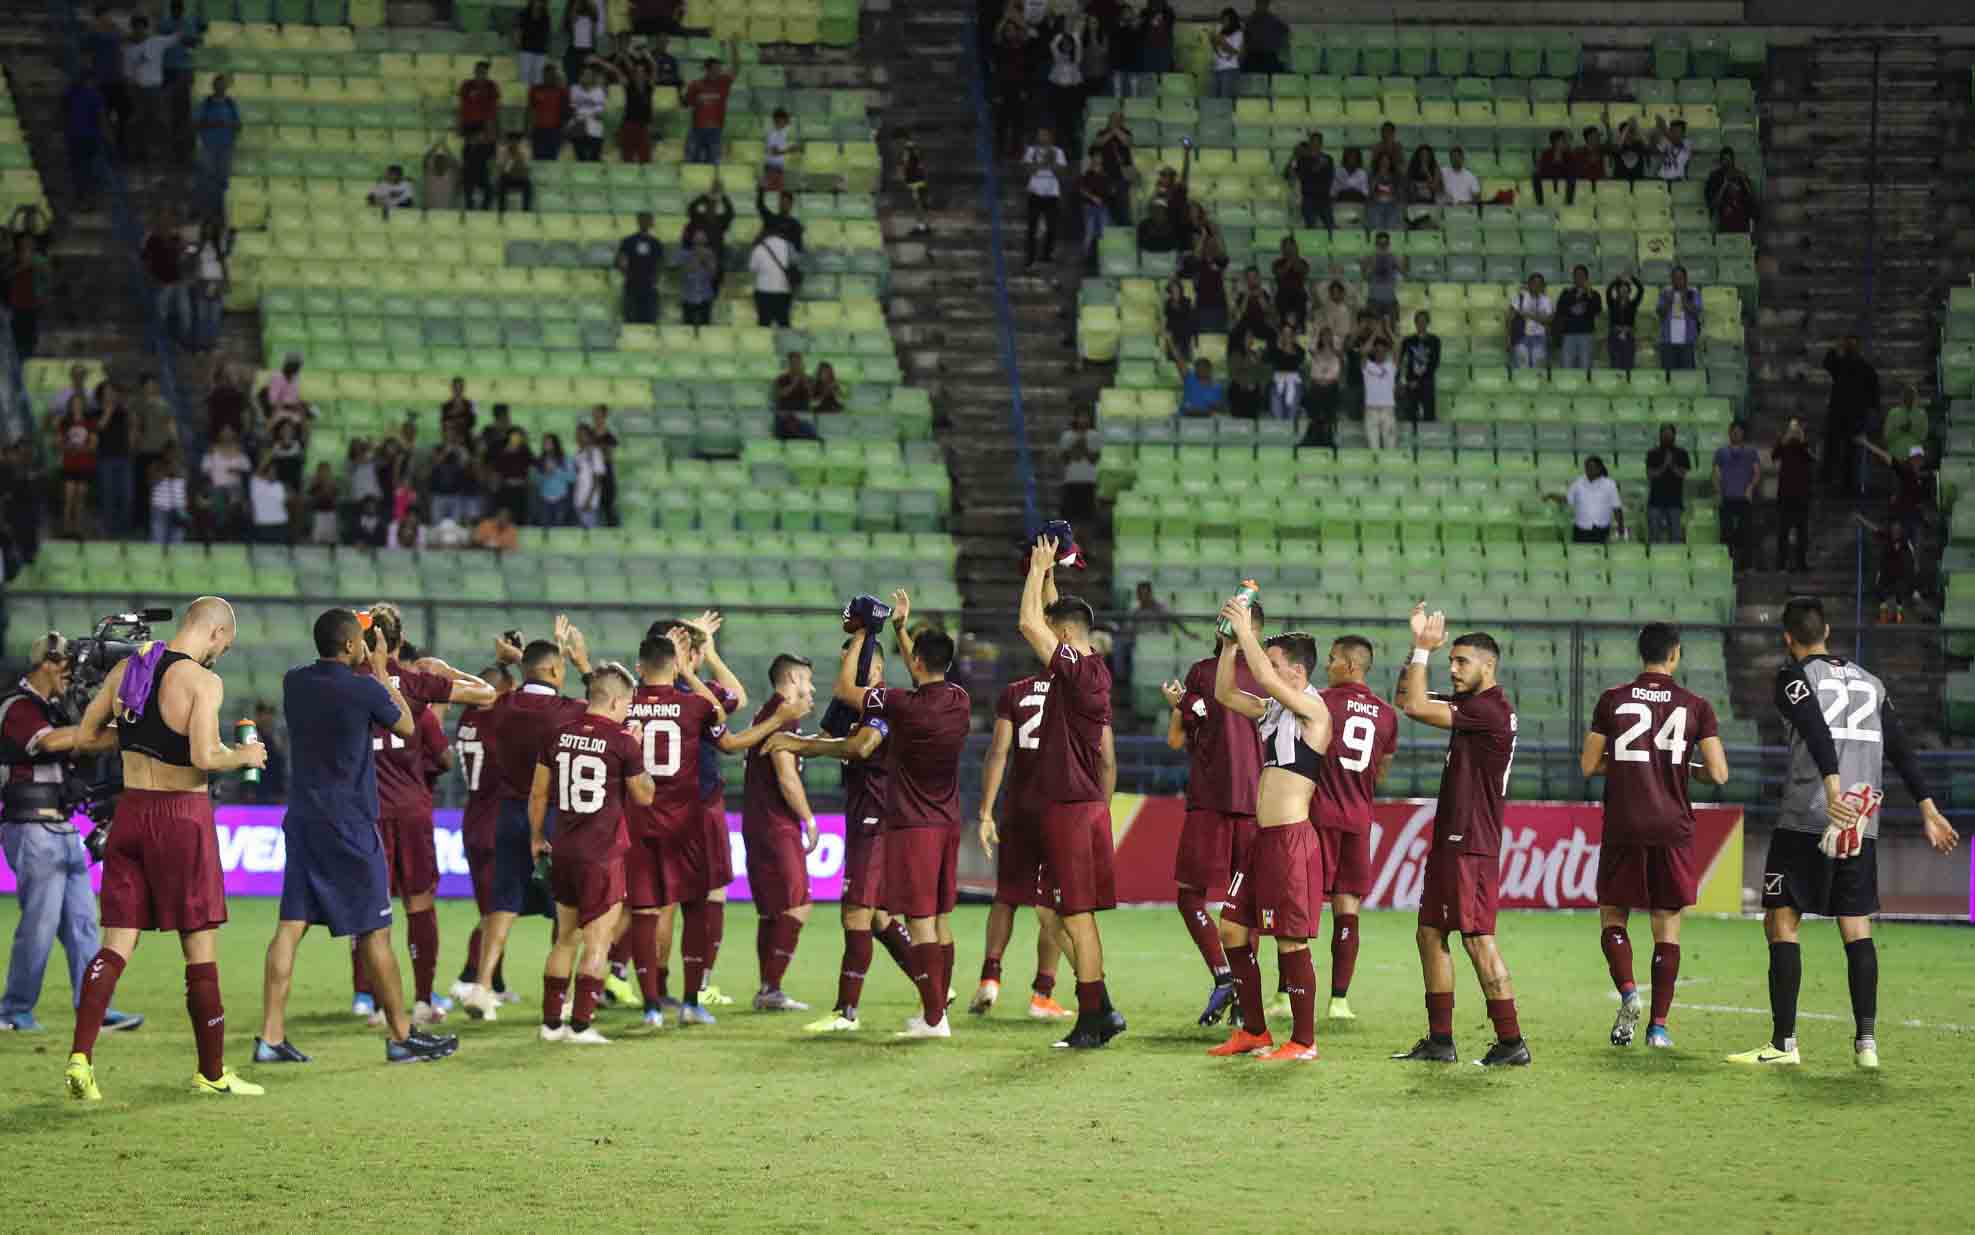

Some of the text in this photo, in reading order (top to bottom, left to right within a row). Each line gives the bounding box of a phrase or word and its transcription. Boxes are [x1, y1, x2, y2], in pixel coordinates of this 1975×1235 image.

[1346, 699, 1380, 718] PONCE
[1631, 687, 1672, 703] OSORIO
[1817, 679, 1881, 742] 22
[559, 733, 607, 753] SOTELDO
[627, 719, 682, 777] 0
[1338, 715, 1376, 773] 9
[1614, 702, 1688, 765] 24
[555, 751, 607, 814] 18
